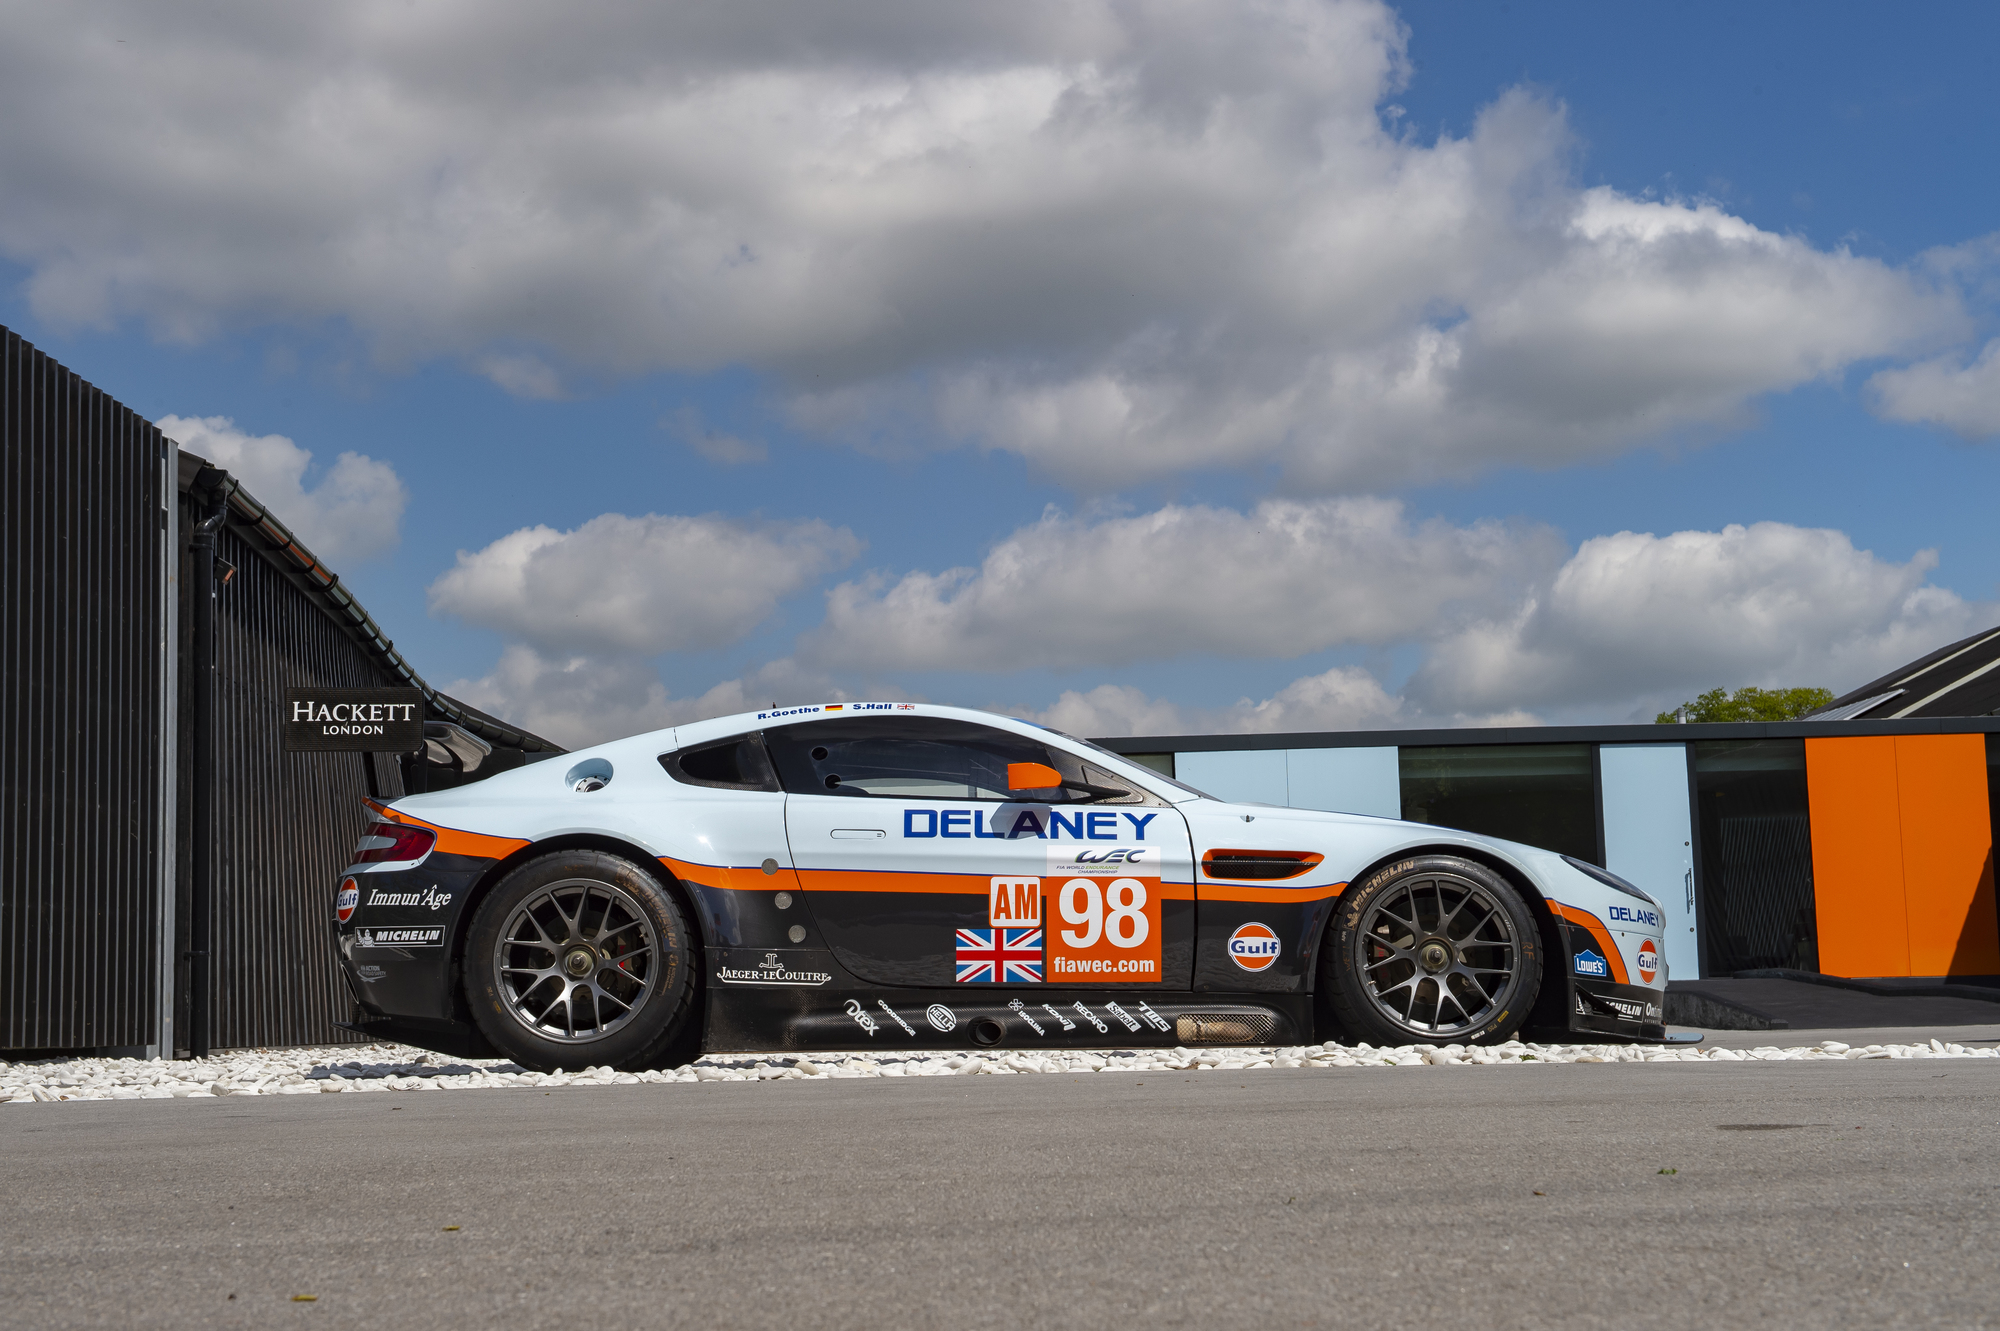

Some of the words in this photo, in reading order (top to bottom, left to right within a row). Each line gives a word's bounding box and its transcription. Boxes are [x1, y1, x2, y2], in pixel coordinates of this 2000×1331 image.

[292, 701, 415, 721] HACKETT
[757, 706, 820, 720] R.Goethe
[323, 725, 383, 735] LONDON
[904, 809, 1158, 841] DELANEY
[1074, 848, 1146, 864] WEC
[1352, 860, 1415, 911] MICHELIN
[338, 893, 358, 906] Gulf
[993, 883, 1038, 920] AM
[1058, 877, 1150, 949] 98
[1609, 906, 1660, 928] DELANEY
[375, 930, 440, 942] MICHELIN
[1231, 940, 1278, 954] Gulf
[1054, 956, 1155, 973] fiawec.com
[1576, 957, 1604, 973] LOWE'S
[1638, 953, 1657, 969] Gulf
[877, 999, 916, 1037] GOODRIDGE
[930, 1006, 956, 1031] HELLA
[1018, 1010, 1045, 1036] ISOCLIMA
[1072, 1001, 1108, 1034] RECARO
[1109, 1004, 1136, 1029] Sabelt
